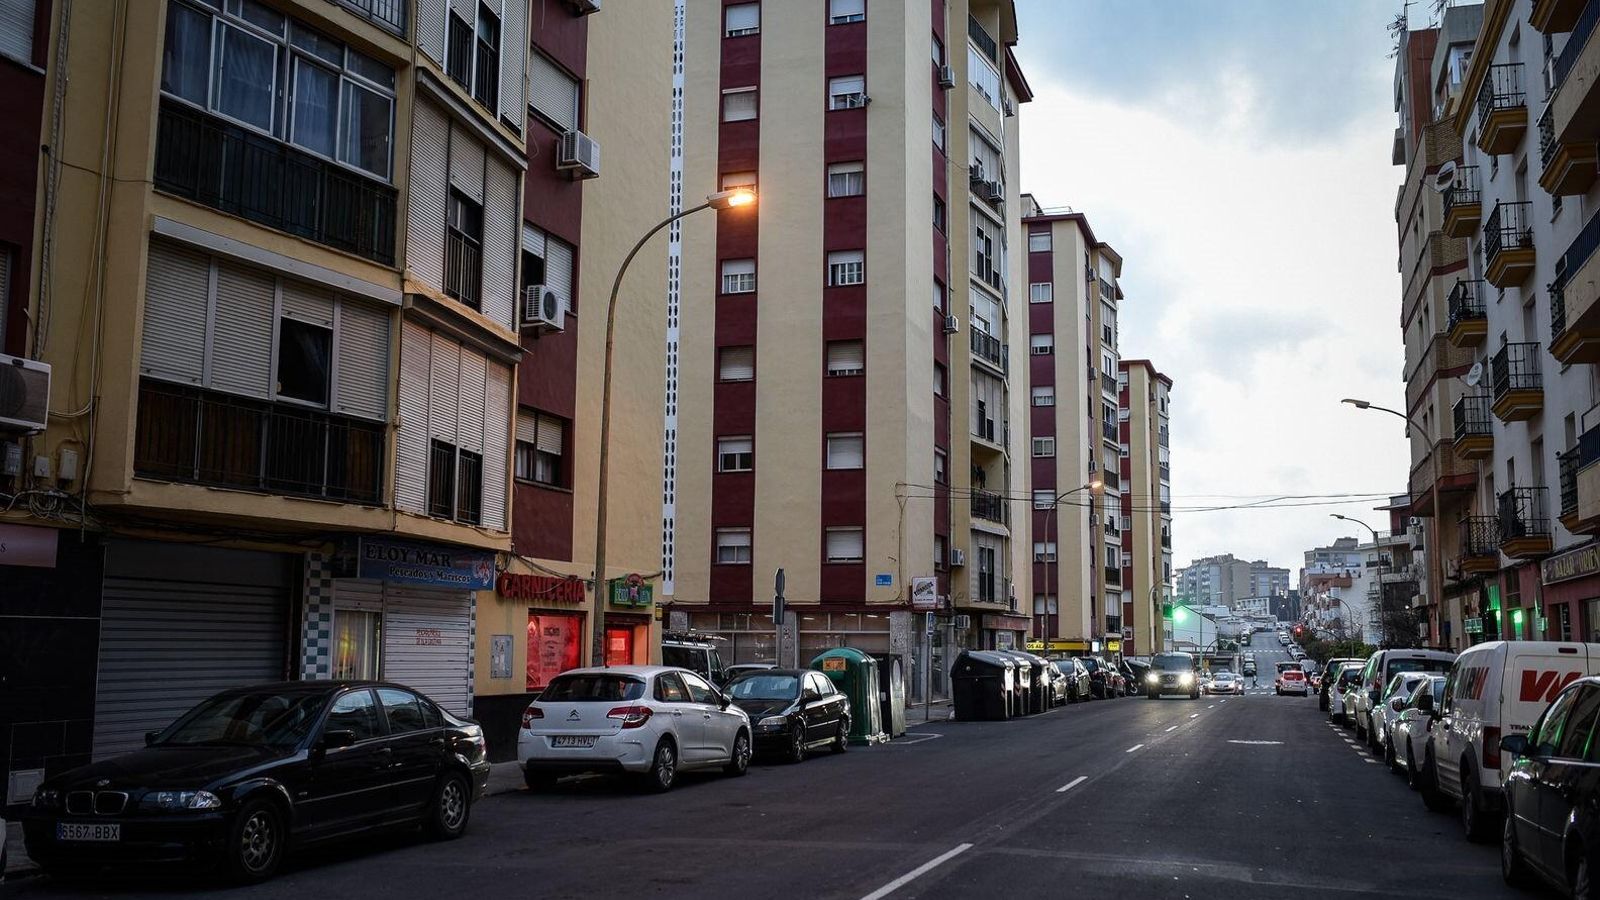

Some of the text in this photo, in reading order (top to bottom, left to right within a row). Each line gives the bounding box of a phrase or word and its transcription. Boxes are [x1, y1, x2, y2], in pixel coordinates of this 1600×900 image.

[365, 543, 452, 568] ELOY MAR
[389, 565, 428, 579] Pescados
[437, 570, 472, 583] Mariscos
[62, 825, 118, 839] 6567 BBX
